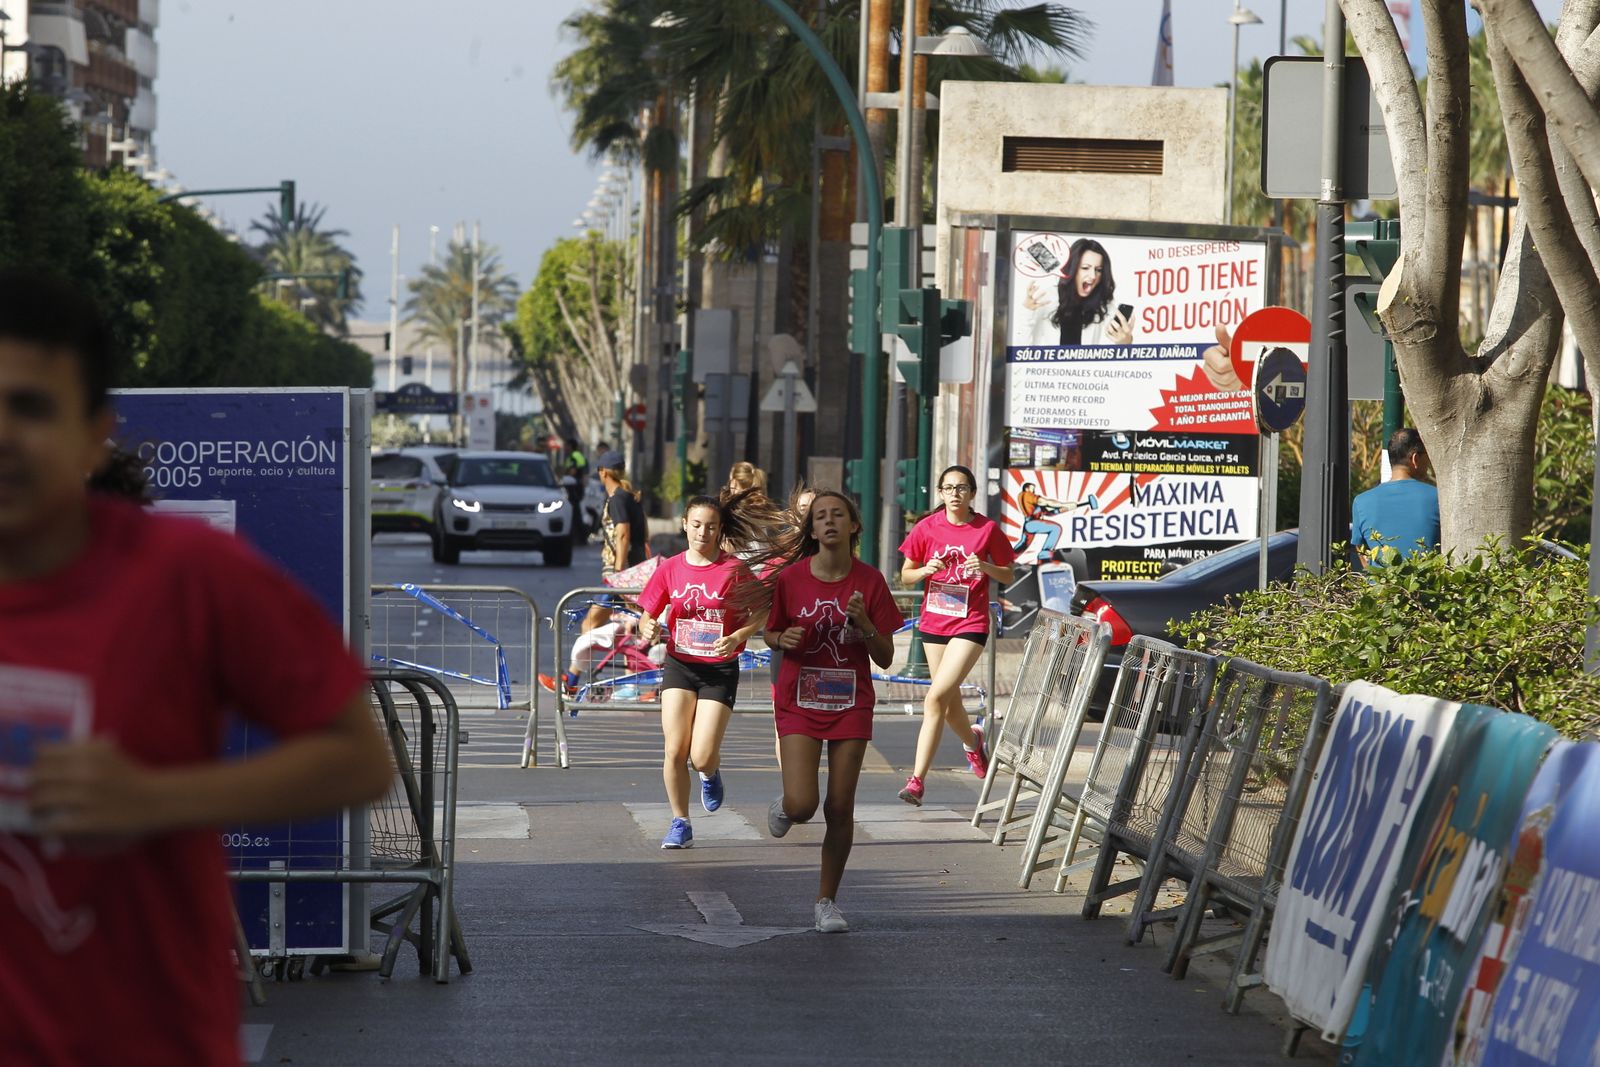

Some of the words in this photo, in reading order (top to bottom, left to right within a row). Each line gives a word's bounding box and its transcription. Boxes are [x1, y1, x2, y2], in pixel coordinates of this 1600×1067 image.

[1148, 248, 1165, 260] NO
[1168, 240, 1241, 258] DESESPERES
[1134, 266, 1190, 298] TODO
[1197, 259, 1258, 291] TIENE
[1142, 291, 1248, 334] SOLUCIÓN
[1015, 348, 1042, 361] SÓLO
[1043, 349, 1056, 360] TE
[1056, 347, 1115, 361] CAMBIAMOS
[1116, 348, 1129, 359] LA
[1130, 346, 1158, 359] PIEZA
[1159, 344, 1198, 358] DAÑADA
[1025, 367, 1091, 378] PROFESIONALES
[1093, 370, 1153, 380] CUALIFICADOS
[1025, 394, 1037, 403] EN
[1039, 395, 1070, 404] TIEMPO
[1169, 396, 1179, 404] AL
[1180, 394, 1205, 403] MEJOR
[1205, 391, 1230, 401] PRECIO
[1231, 390, 1237, 399] Y
[1023, 407, 1077, 417] MEJORAMOS
[1078, 408, 1088, 418] EL
[1174, 404, 1197, 413] TOTAL
[1198, 401, 1252, 412] TRANQUILIDAD:
[1023, 416, 1051, 425] MEJOR
[1052, 418, 1111, 428] PRESUPUESTO
[1169, 417, 1175, 426] 1
[1176, 415, 1196, 426] AÑO
[1196, 414, 1208, 424] DE
[1209, 409, 1252, 424] GARANTÍA
[138, 435, 336, 465] COOPERACIÓN
[1101, 450, 1121, 460] Avd.
[1159, 452, 1187, 461] García
[1226, 454, 1239, 463] 54
[1090, 462, 1100, 471] TU
[1100, 462, 1124, 472] TIENDA
[1134, 462, 1175, 473] REPARACIÓN
[1176, 465, 1186, 473] DE
[1186, 463, 1215, 474] MÓVILES
[1215, 466, 1221, 474] Y
[1221, 465, 1250, 475] TABLETS
[143, 466, 202, 488] 2005
[260, 466, 284, 476] ocio
[287, 468, 294, 478] y
[297, 466, 336, 476] cultura
[1135, 477, 1225, 507] MÁXIMA
[1071, 508, 1240, 543] RESISTENCIA
[1143, 548, 1167, 559] PARA
